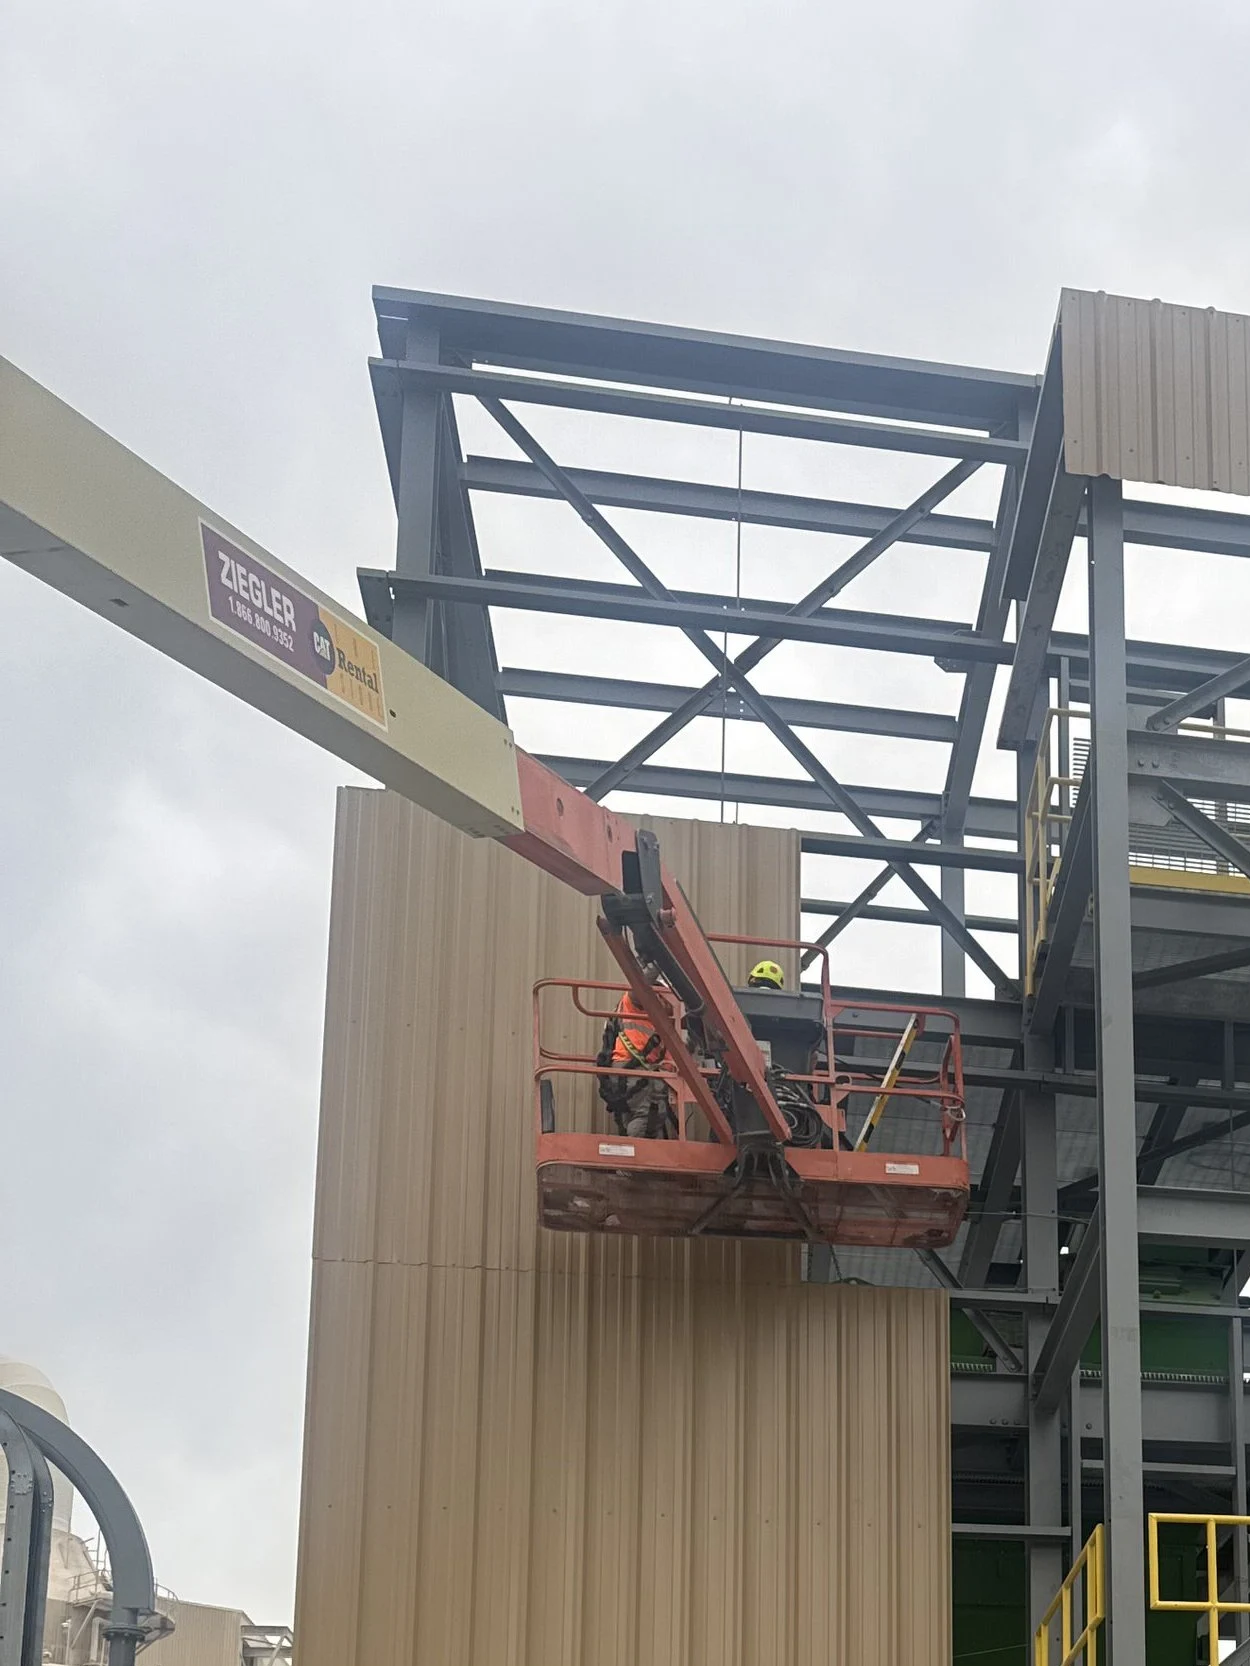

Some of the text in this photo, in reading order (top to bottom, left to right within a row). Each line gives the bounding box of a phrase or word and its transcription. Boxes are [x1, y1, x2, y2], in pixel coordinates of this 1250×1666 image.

[217, 550, 297, 632] ZIEGLER
[228, 595, 295, 653] 1.866.800.9352
[313, 631, 331, 662] CAT
[336, 646, 379, 694] Rental
